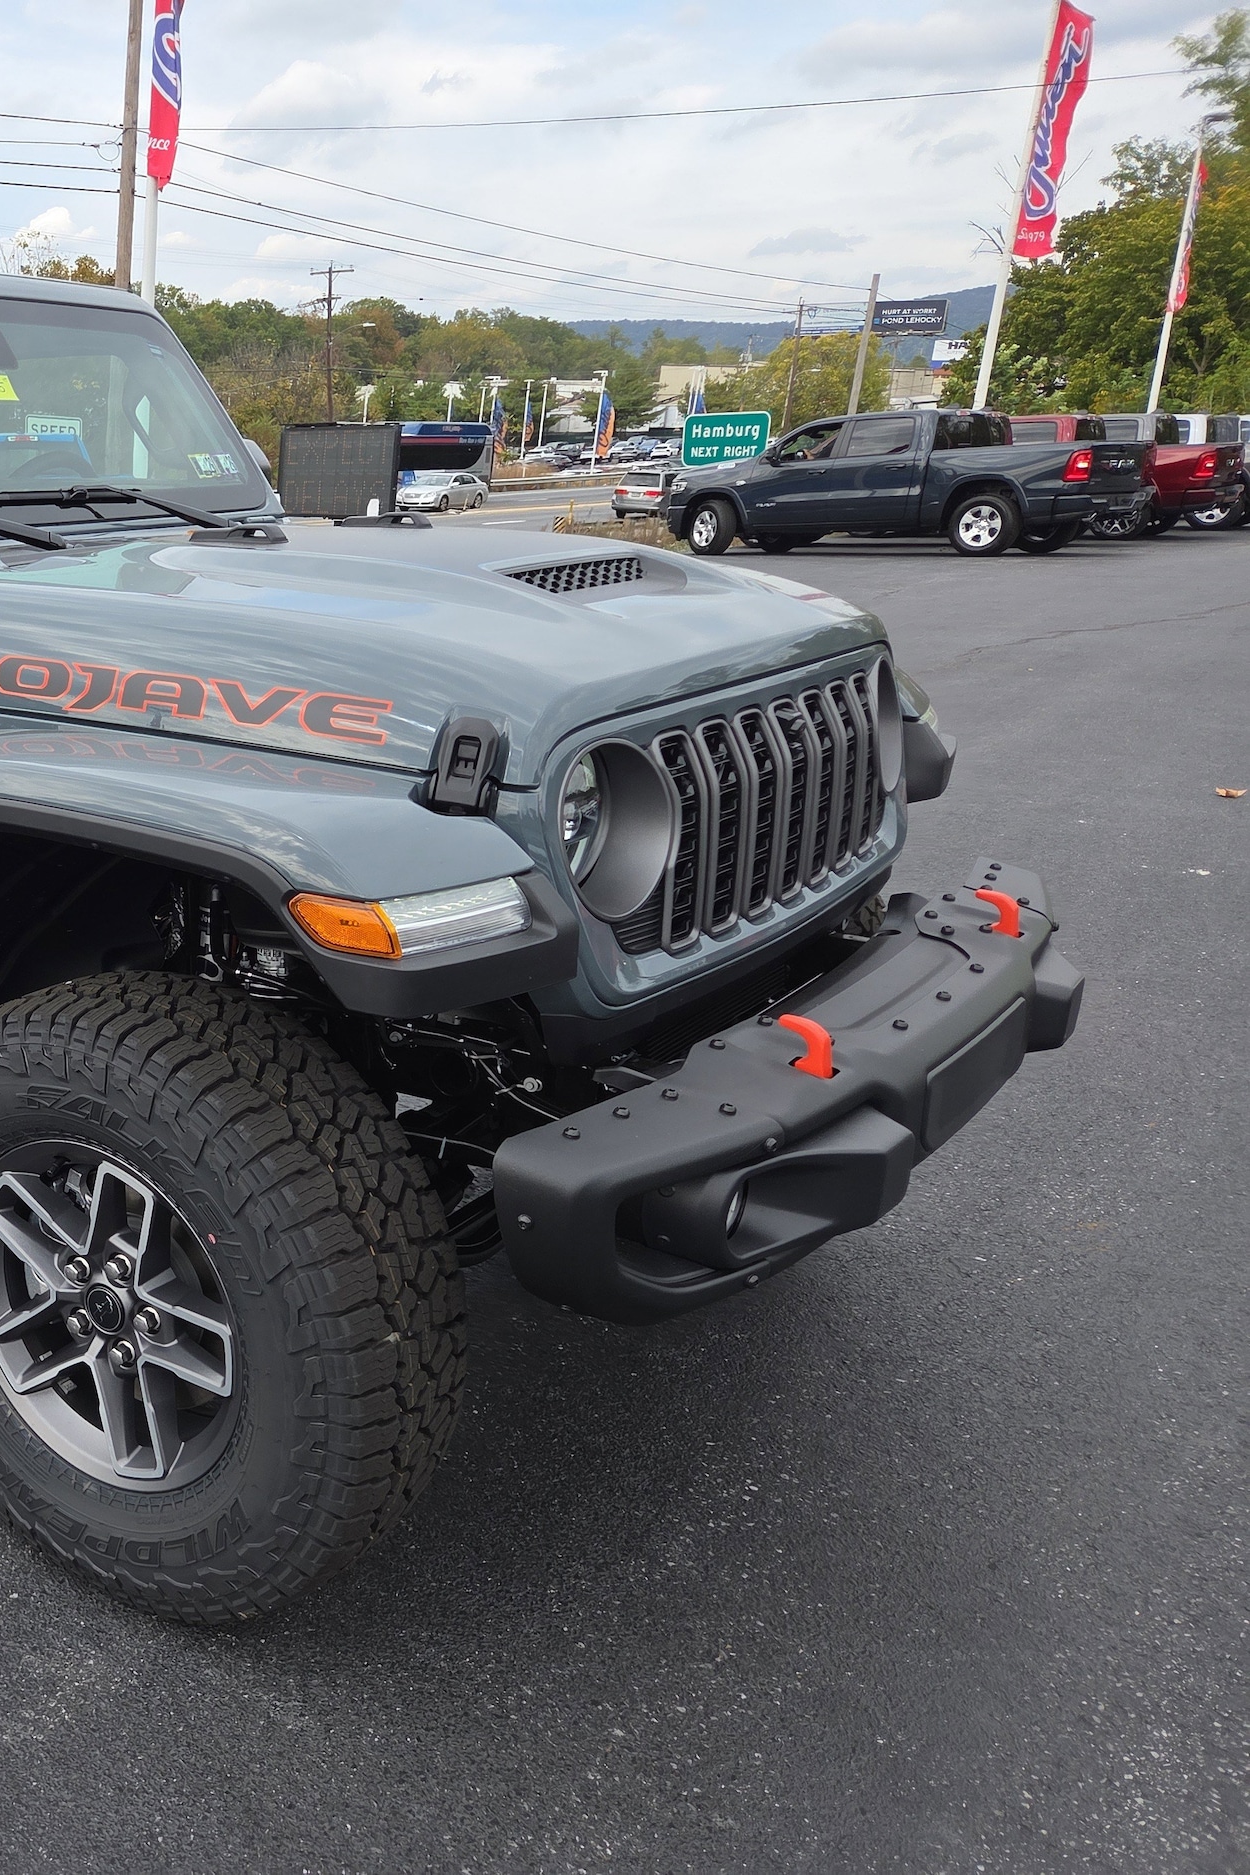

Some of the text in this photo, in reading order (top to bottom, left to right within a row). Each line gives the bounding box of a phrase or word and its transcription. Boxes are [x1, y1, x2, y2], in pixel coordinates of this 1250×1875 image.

[905, 316, 943, 324] LEHOCKY
[31, 424, 76, 435] SPEED
[691, 423, 761, 441] Hamburg
[690, 445, 758, 458] NEXT RIGHT
